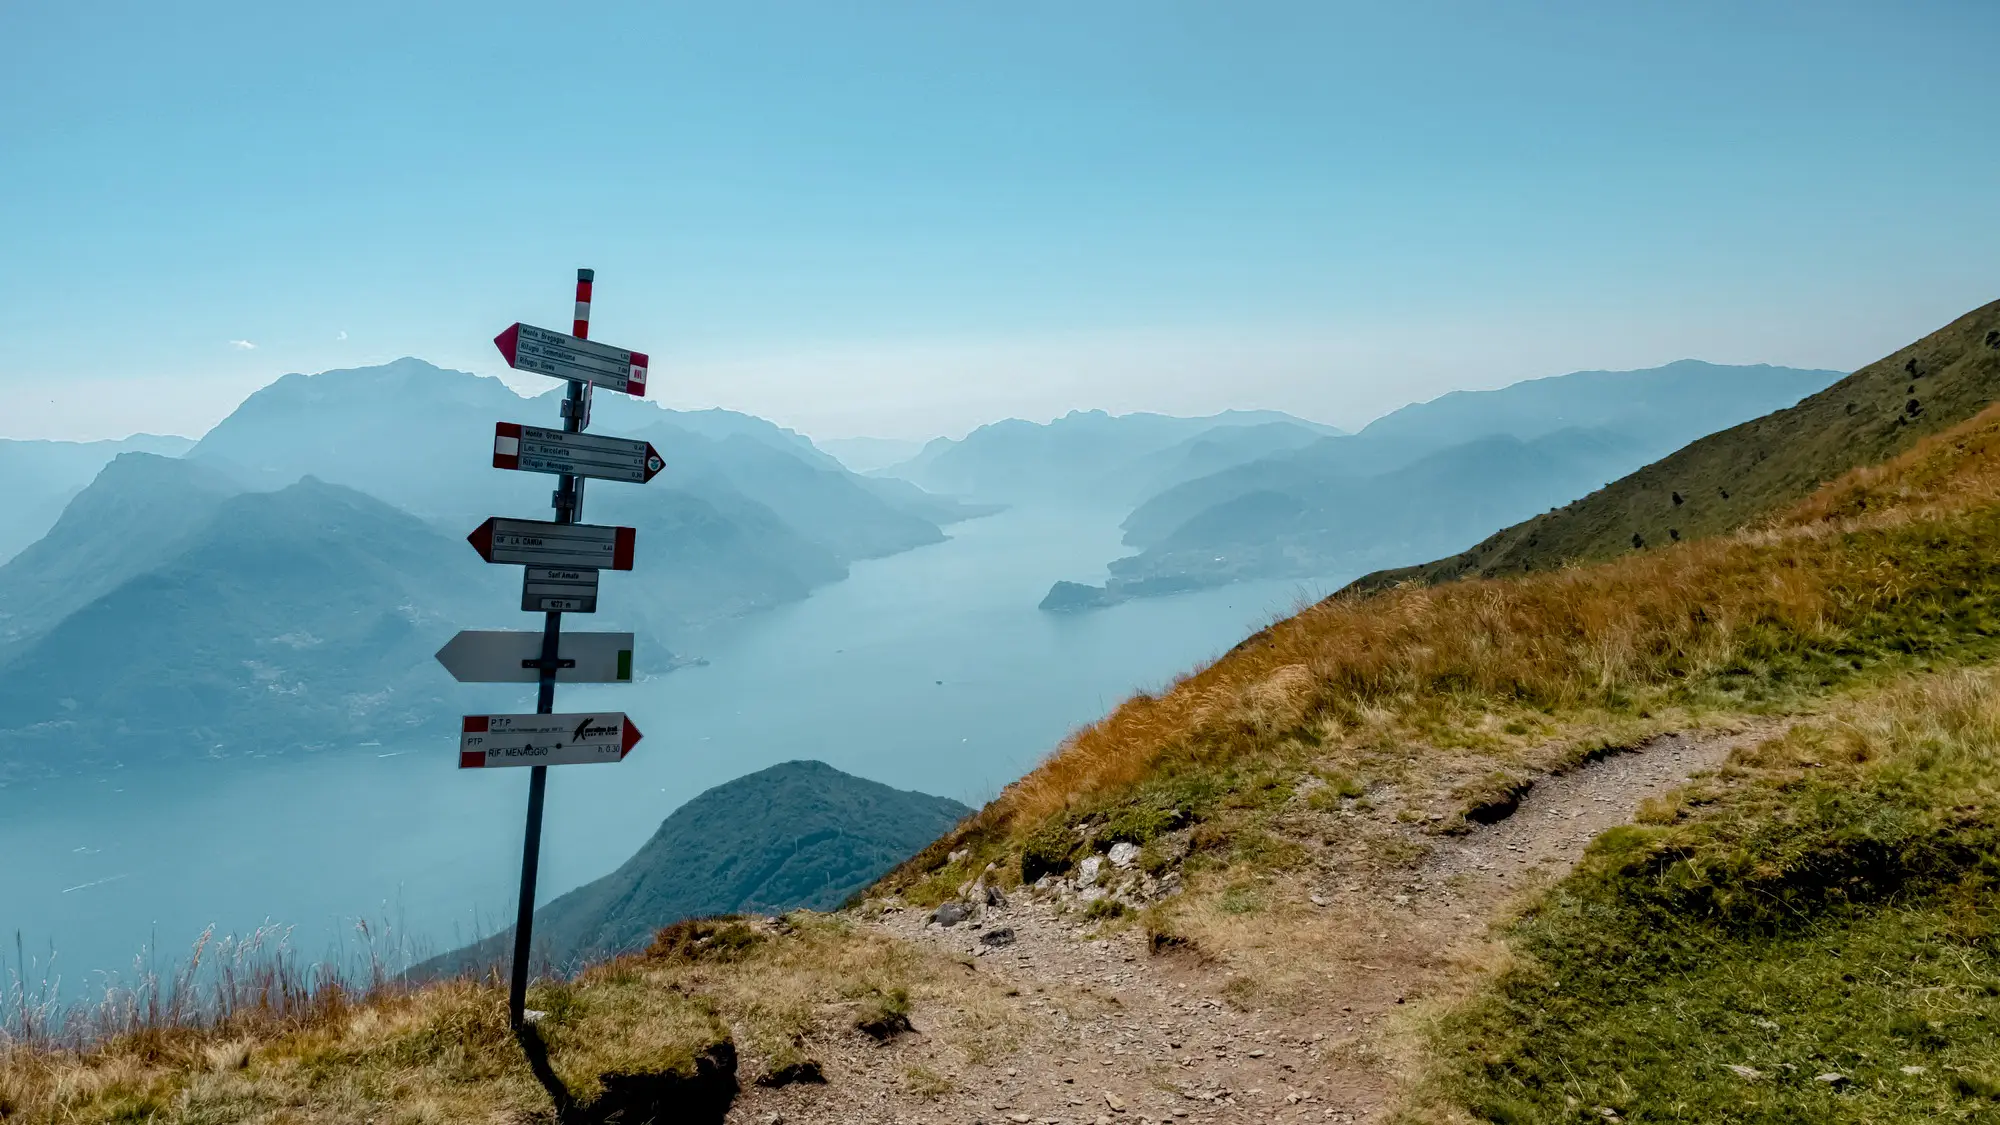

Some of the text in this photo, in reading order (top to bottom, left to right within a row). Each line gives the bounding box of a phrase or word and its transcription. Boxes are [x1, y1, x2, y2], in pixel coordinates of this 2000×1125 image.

[522, 327, 538, 338] Monte
[525, 429, 563, 441] Monte Grona
[522, 458, 574, 472] Rifugio Menaggio
[510, 537, 520, 545] LA
[467, 737, 483, 746] PTP
[505, 747, 549, 757] MENAGGIO
